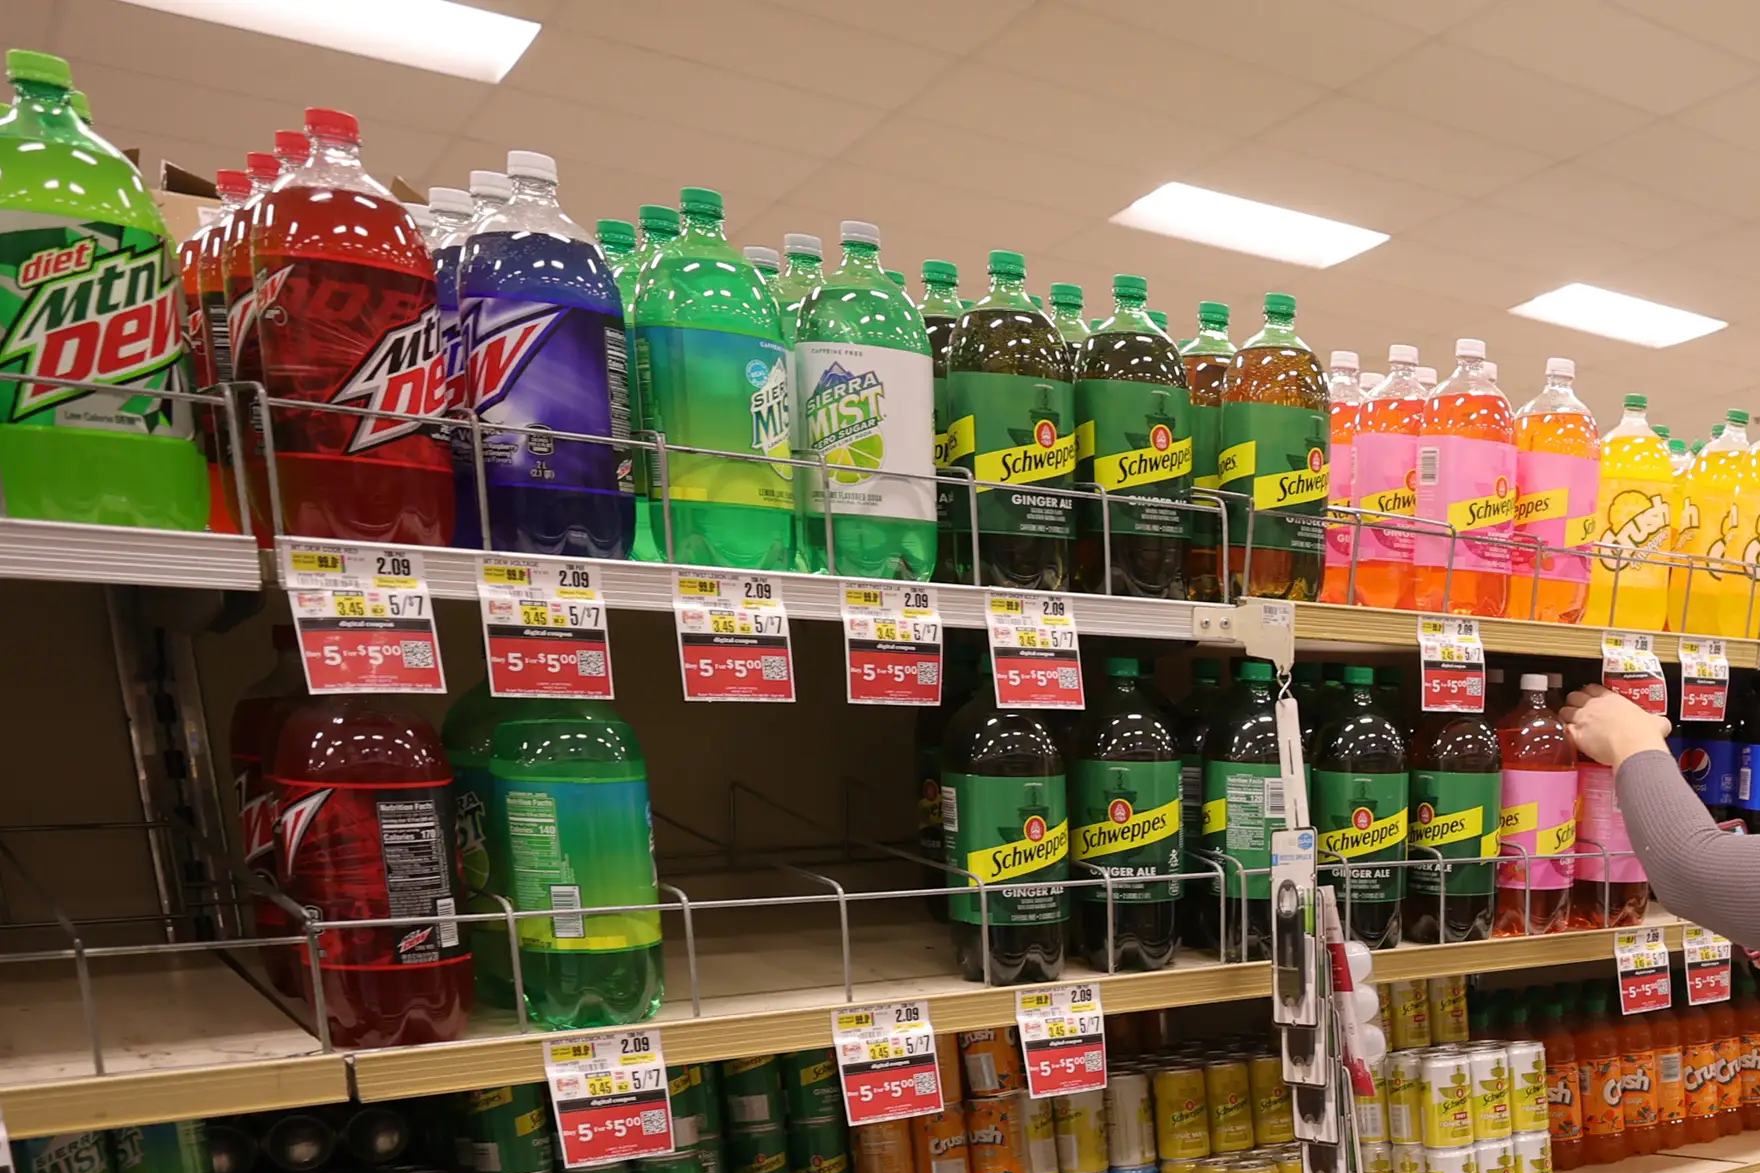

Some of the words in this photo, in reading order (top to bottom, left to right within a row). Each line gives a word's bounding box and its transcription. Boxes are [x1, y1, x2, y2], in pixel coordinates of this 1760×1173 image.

[22, 244, 92, 284] diet
[22, 260, 157, 340] Mtn
[807, 372, 877, 411] SIERRA
[809, 386, 885, 448] MIST
[838, 419, 876, 439] SUGAR
[1011, 495, 1058, 508] GINGER
[376, 557, 411, 576] 2.09
[559, 570, 589, 588] 2.09
[745, 582, 771, 599] 2.09
[904, 592, 928, 608] 2.09
[1043, 601, 1065, 616] 2.09
[338, 602, 365, 616] 3.45
[524, 612, 547, 625] 3.45
[714, 621, 734, 632] 3.45
[323, 646, 342, 666] 5
[507, 652, 524, 672] 5
[699, 659, 714, 677] 5
[383, 833, 415, 841] Calories
[420, 829, 436, 839] 170
[539, 826, 555, 834] 140
[1082, 811, 1167, 854] Schweppes
[1325, 819, 1400, 861] Schweppes
[1134, 866, 1156, 877] ALE
[1372, 868, 1390, 878] ALE
[1002, 885, 1047, 898] GINGER
[622, 1037, 649, 1054] 2.09
[589, 1081, 612, 1095] 3.45
[578, 1124, 592, 1141] 5
